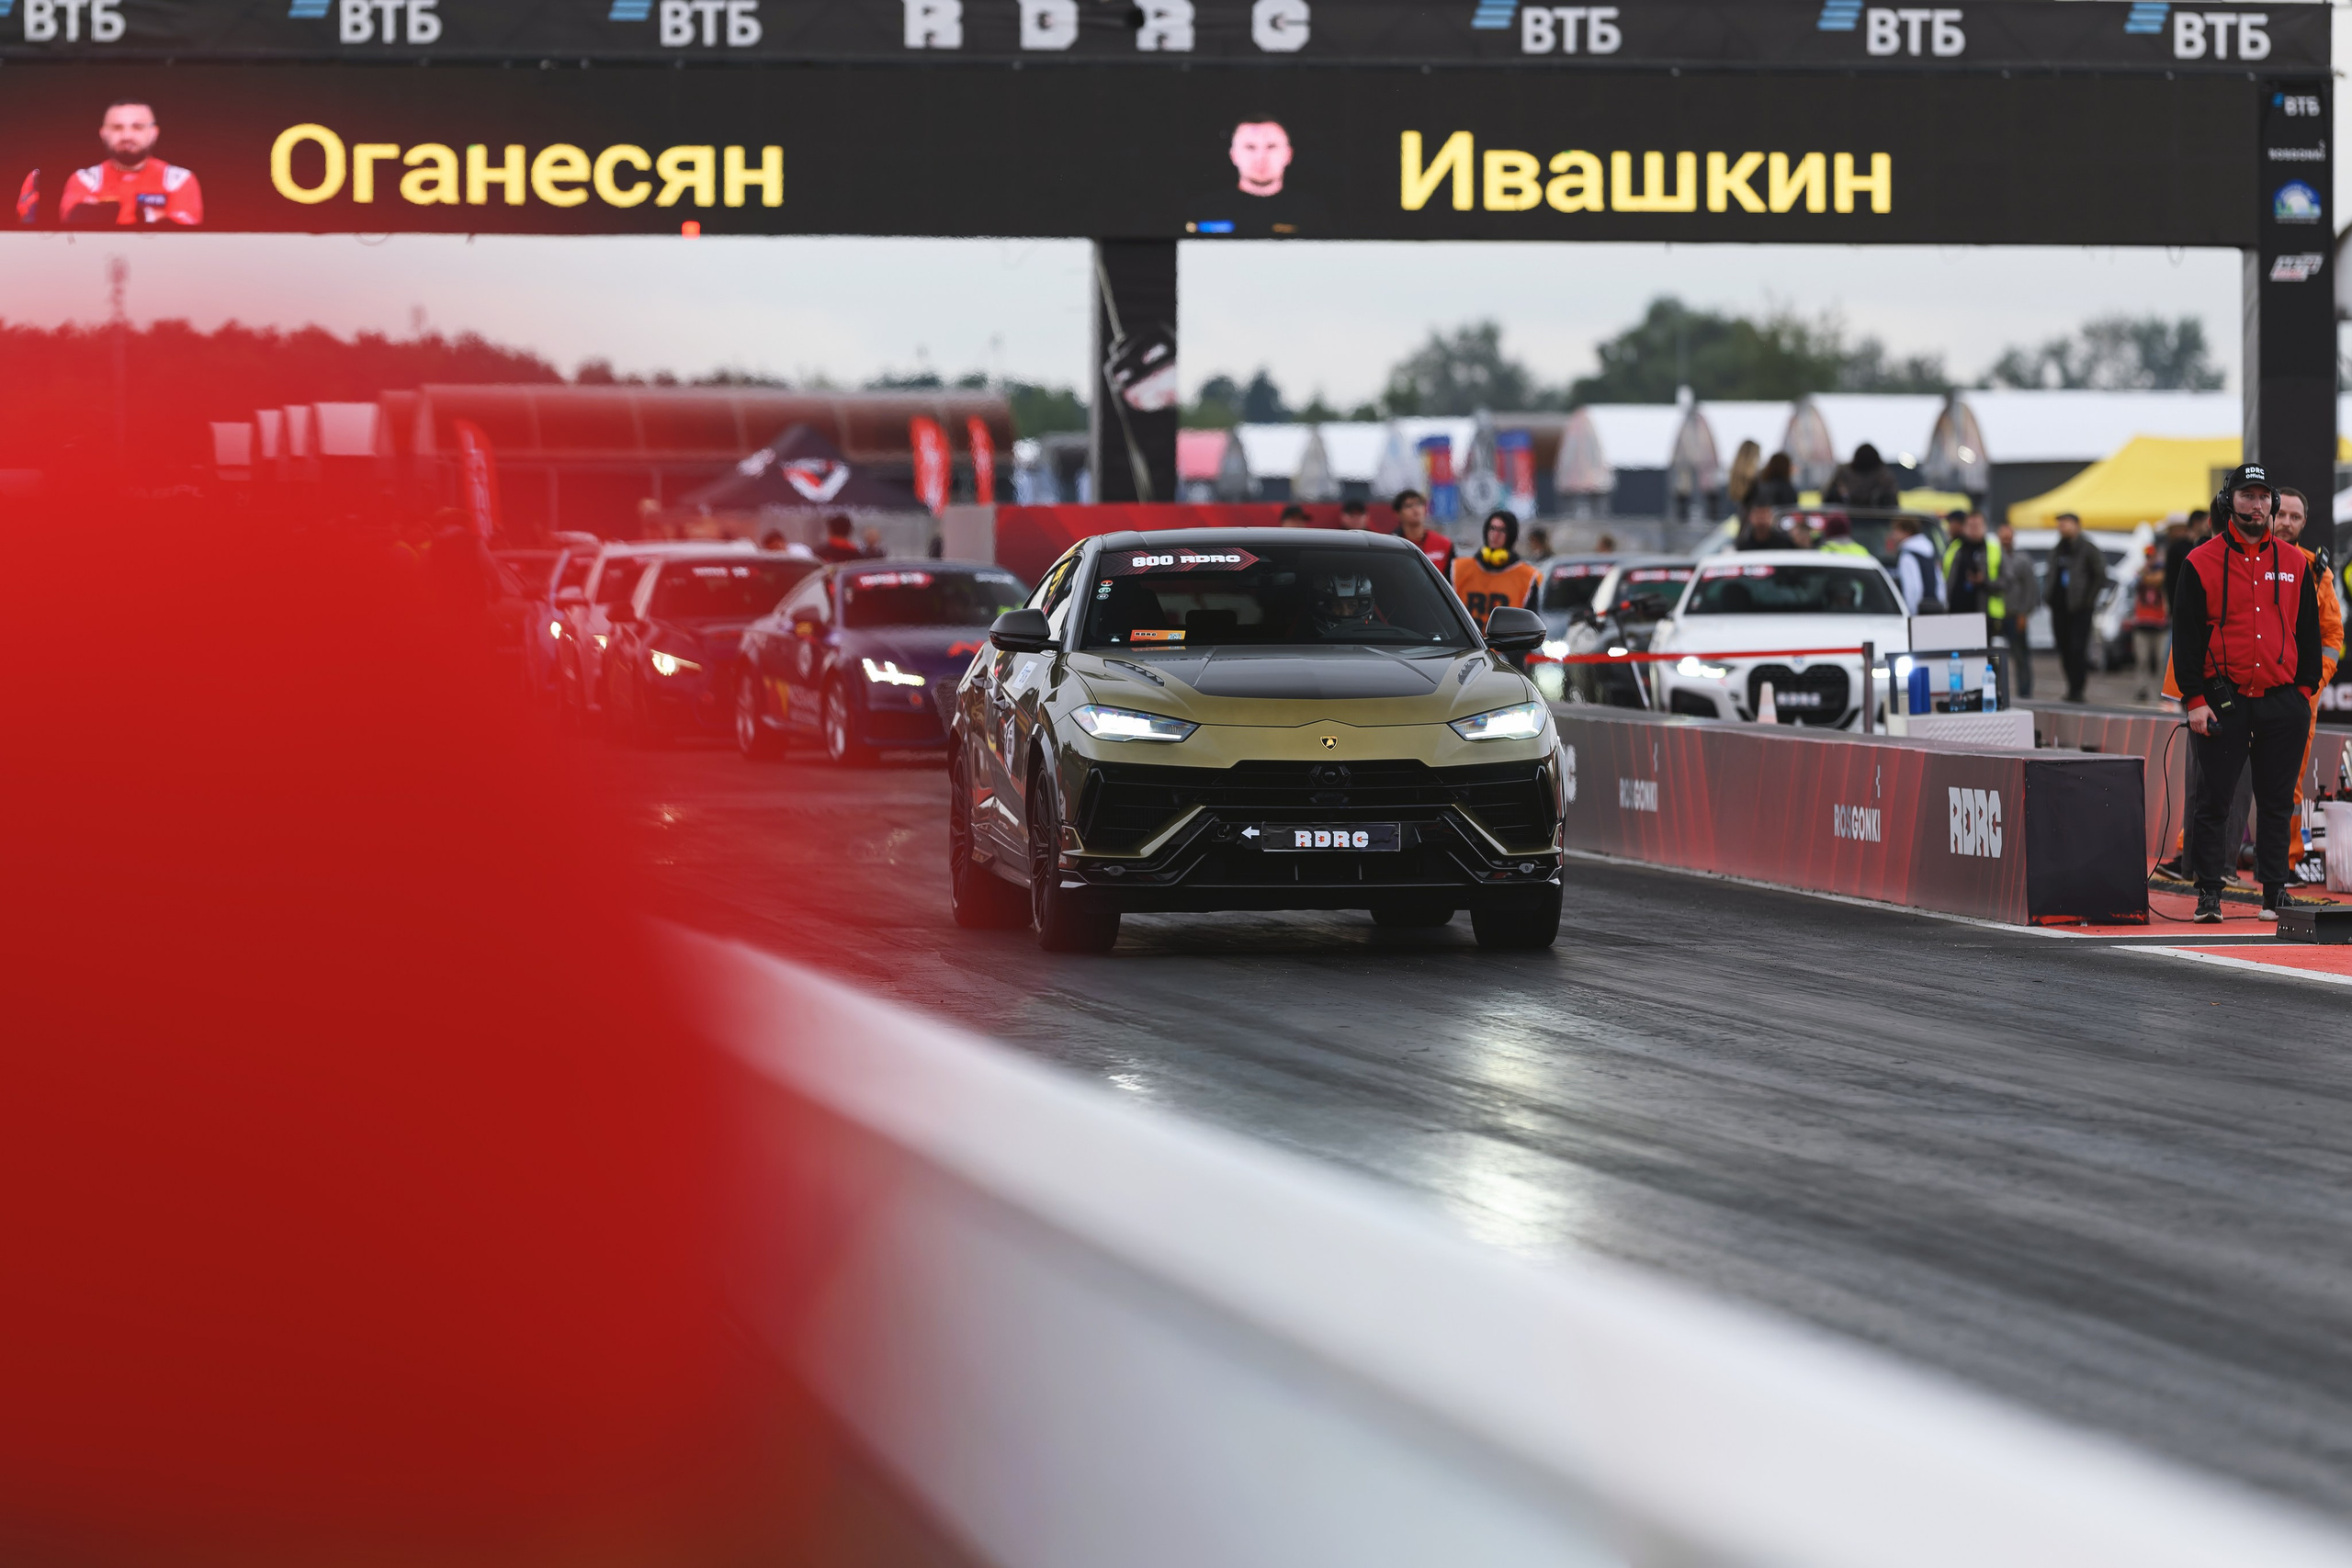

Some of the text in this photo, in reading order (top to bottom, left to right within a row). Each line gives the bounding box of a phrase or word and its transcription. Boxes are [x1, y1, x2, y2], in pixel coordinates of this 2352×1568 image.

[23, 0, 127, 42] ВТБ
[339, 0, 443, 44] ВТБ
[660, 2, 763, 47] ВТБ
[1521, 6, 1623, 54] ВТБ
[1866, 8, 1966, 57] ВТБ
[2173, 12, 2272, 60] ВТБ
[2284, 96, 2321, 117] ВТБ
[270, 123, 785, 208] Оганесян
[1399, 130, 1893, 214] Ивашкин
[2245, 467, 2265, 475] RDRC
[1132, 555, 1241, 568] 800 RDRC
[1295, 830, 1369, 848] RDRC
[1834, 804, 1882, 843] ROSGONKI
[1948, 786, 2003, 859] RDRC
